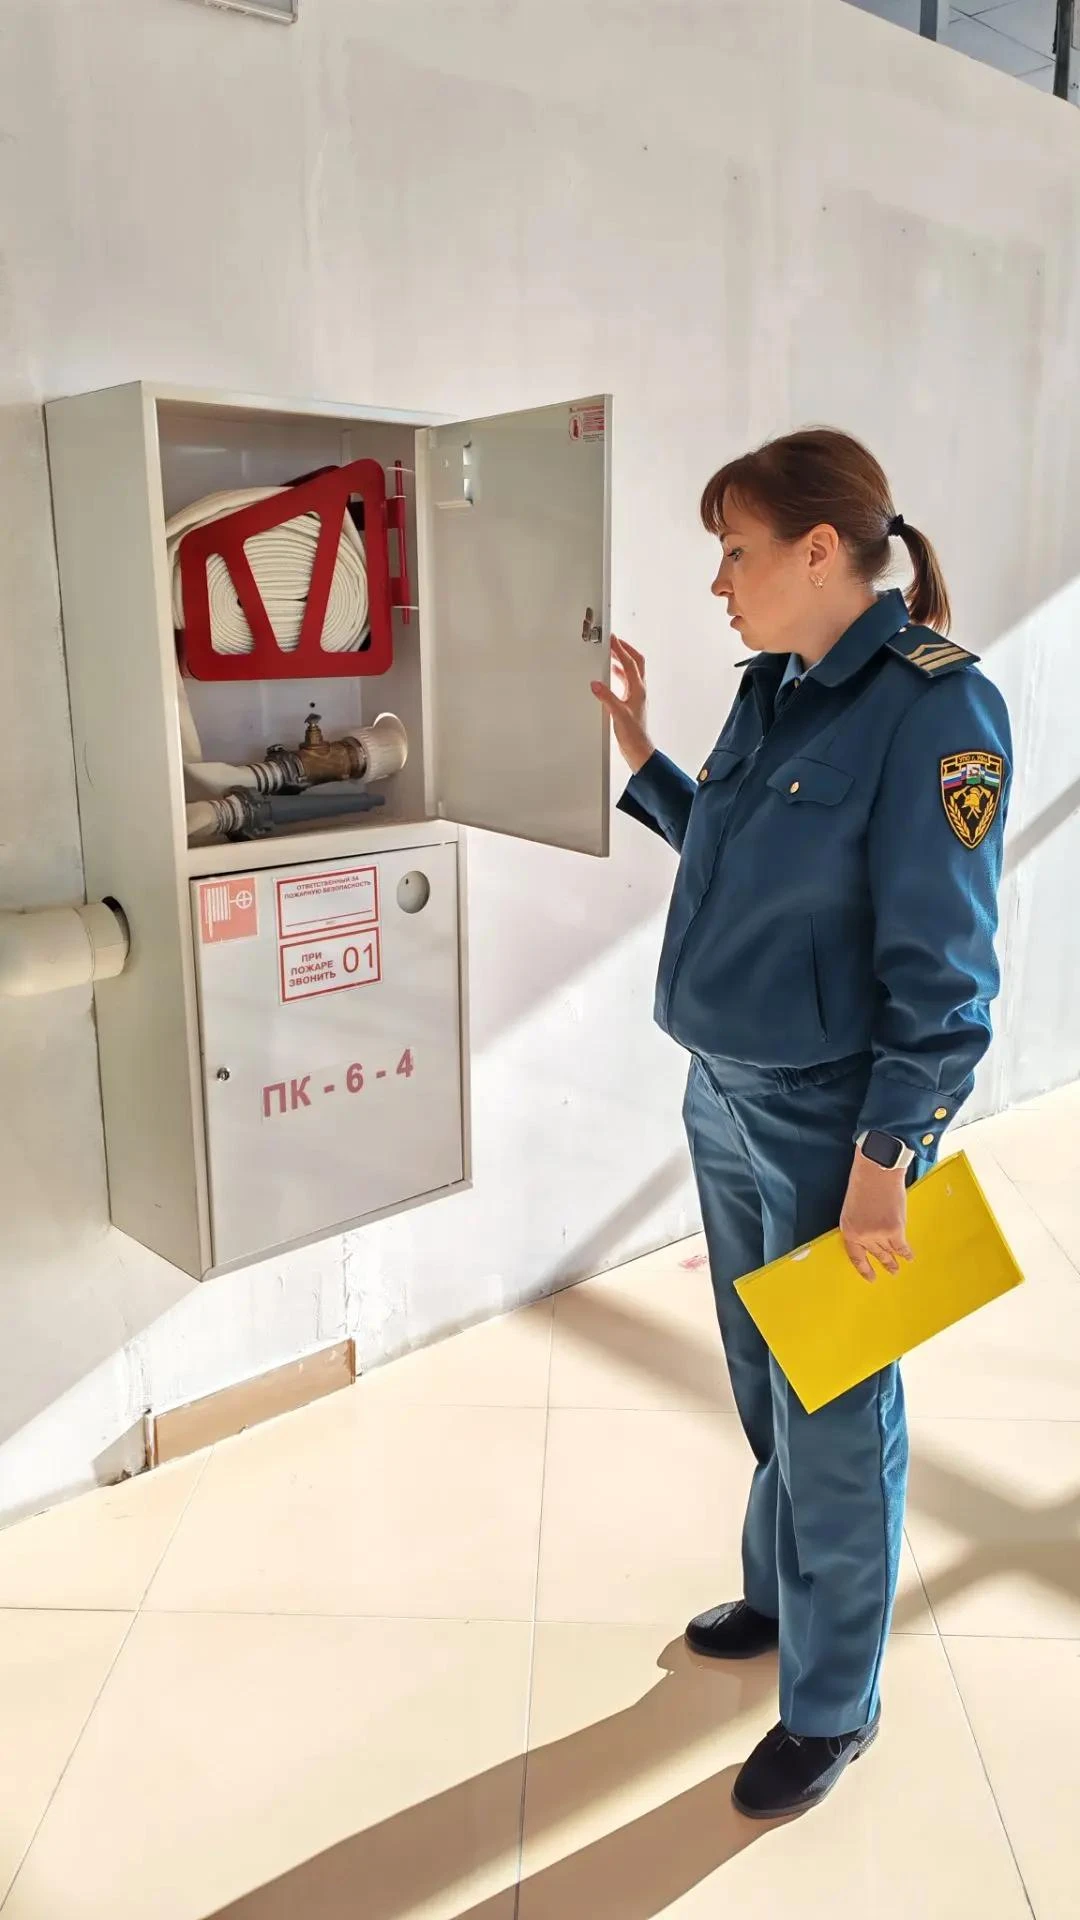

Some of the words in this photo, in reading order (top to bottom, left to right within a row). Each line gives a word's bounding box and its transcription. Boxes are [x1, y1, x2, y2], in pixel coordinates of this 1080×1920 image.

[284, 888, 322, 899] ПОЖАРНУЮ
[322, 880, 371, 894] БЕЗОПАСНОСТЬ
[296, 876, 350, 890] ОТВЕТСТВЕННЫЙ
[301, 951, 322, 962] ПРИ
[342, 942, 373, 973] 01
[290, 960, 333, 976] ПОЖАРЕ
[288, 971, 336, 987] ЗВОНИТЬ
[262, 1075, 312, 1117] ПК
[346, 1062, 364, 1093] 6
[396, 1048, 414, 1078] 4
